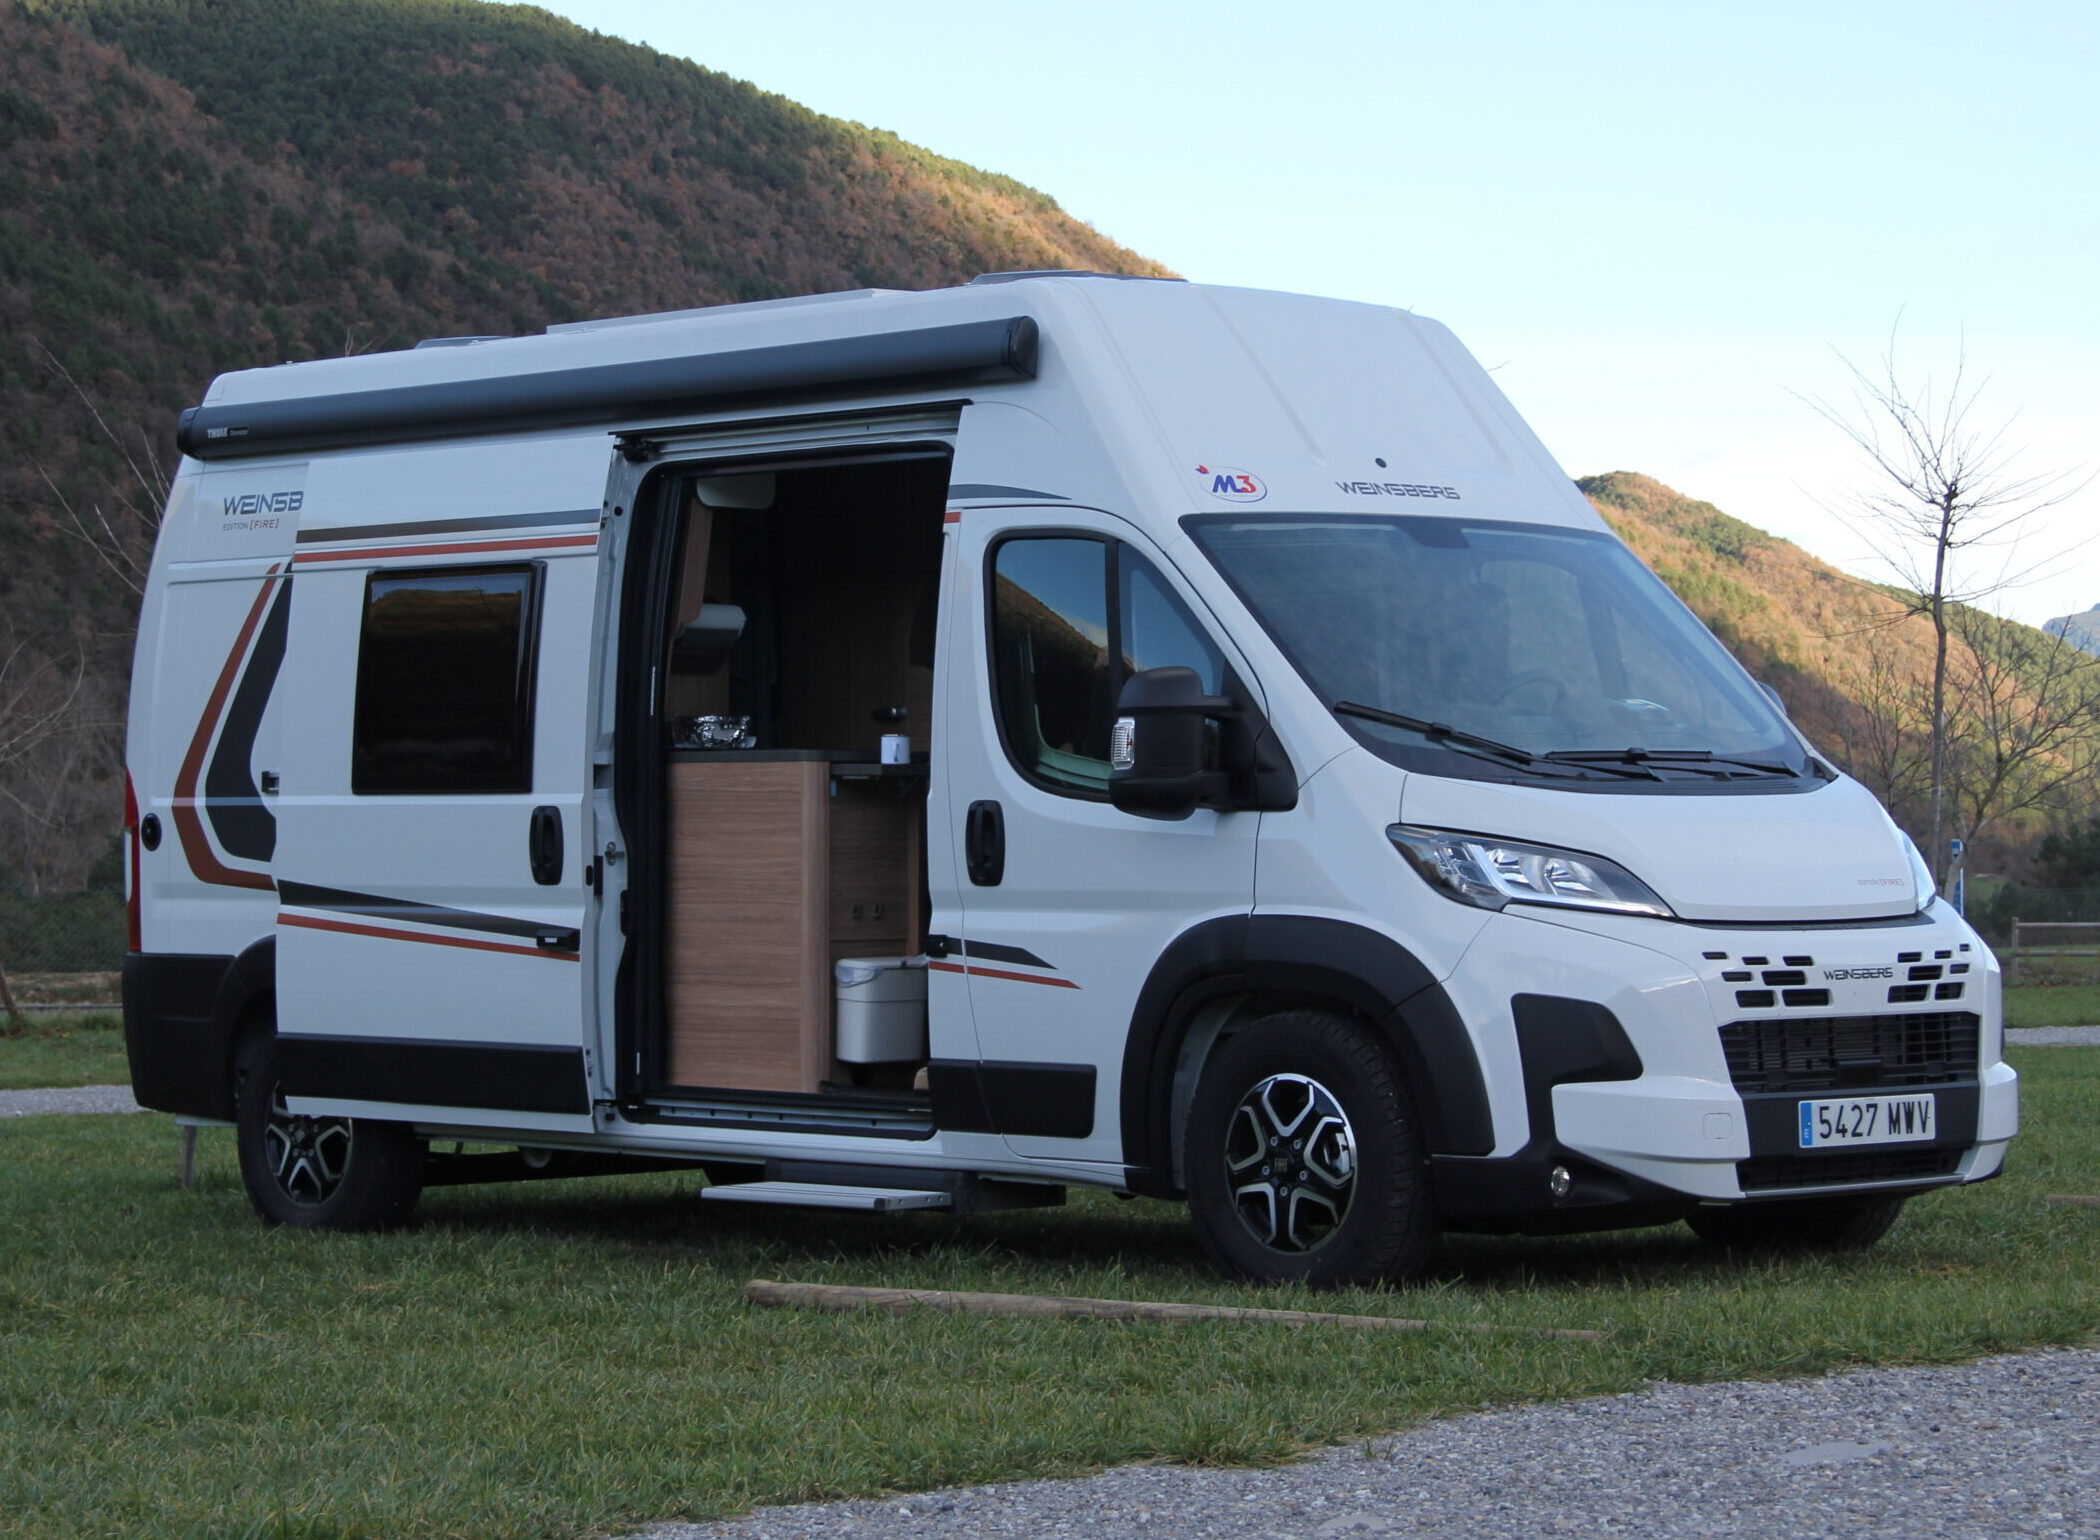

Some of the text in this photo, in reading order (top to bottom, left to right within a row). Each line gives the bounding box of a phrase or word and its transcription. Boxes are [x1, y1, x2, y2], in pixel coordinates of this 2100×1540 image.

[1212, 475, 1257, 493] M3
[1335, 481, 1461, 500] WEINSBERG
[223, 491, 304, 516] WEINSB
[222, 522, 248, 531] EDITION
[1818, 1101, 1929, 1140] 5427 MWV
